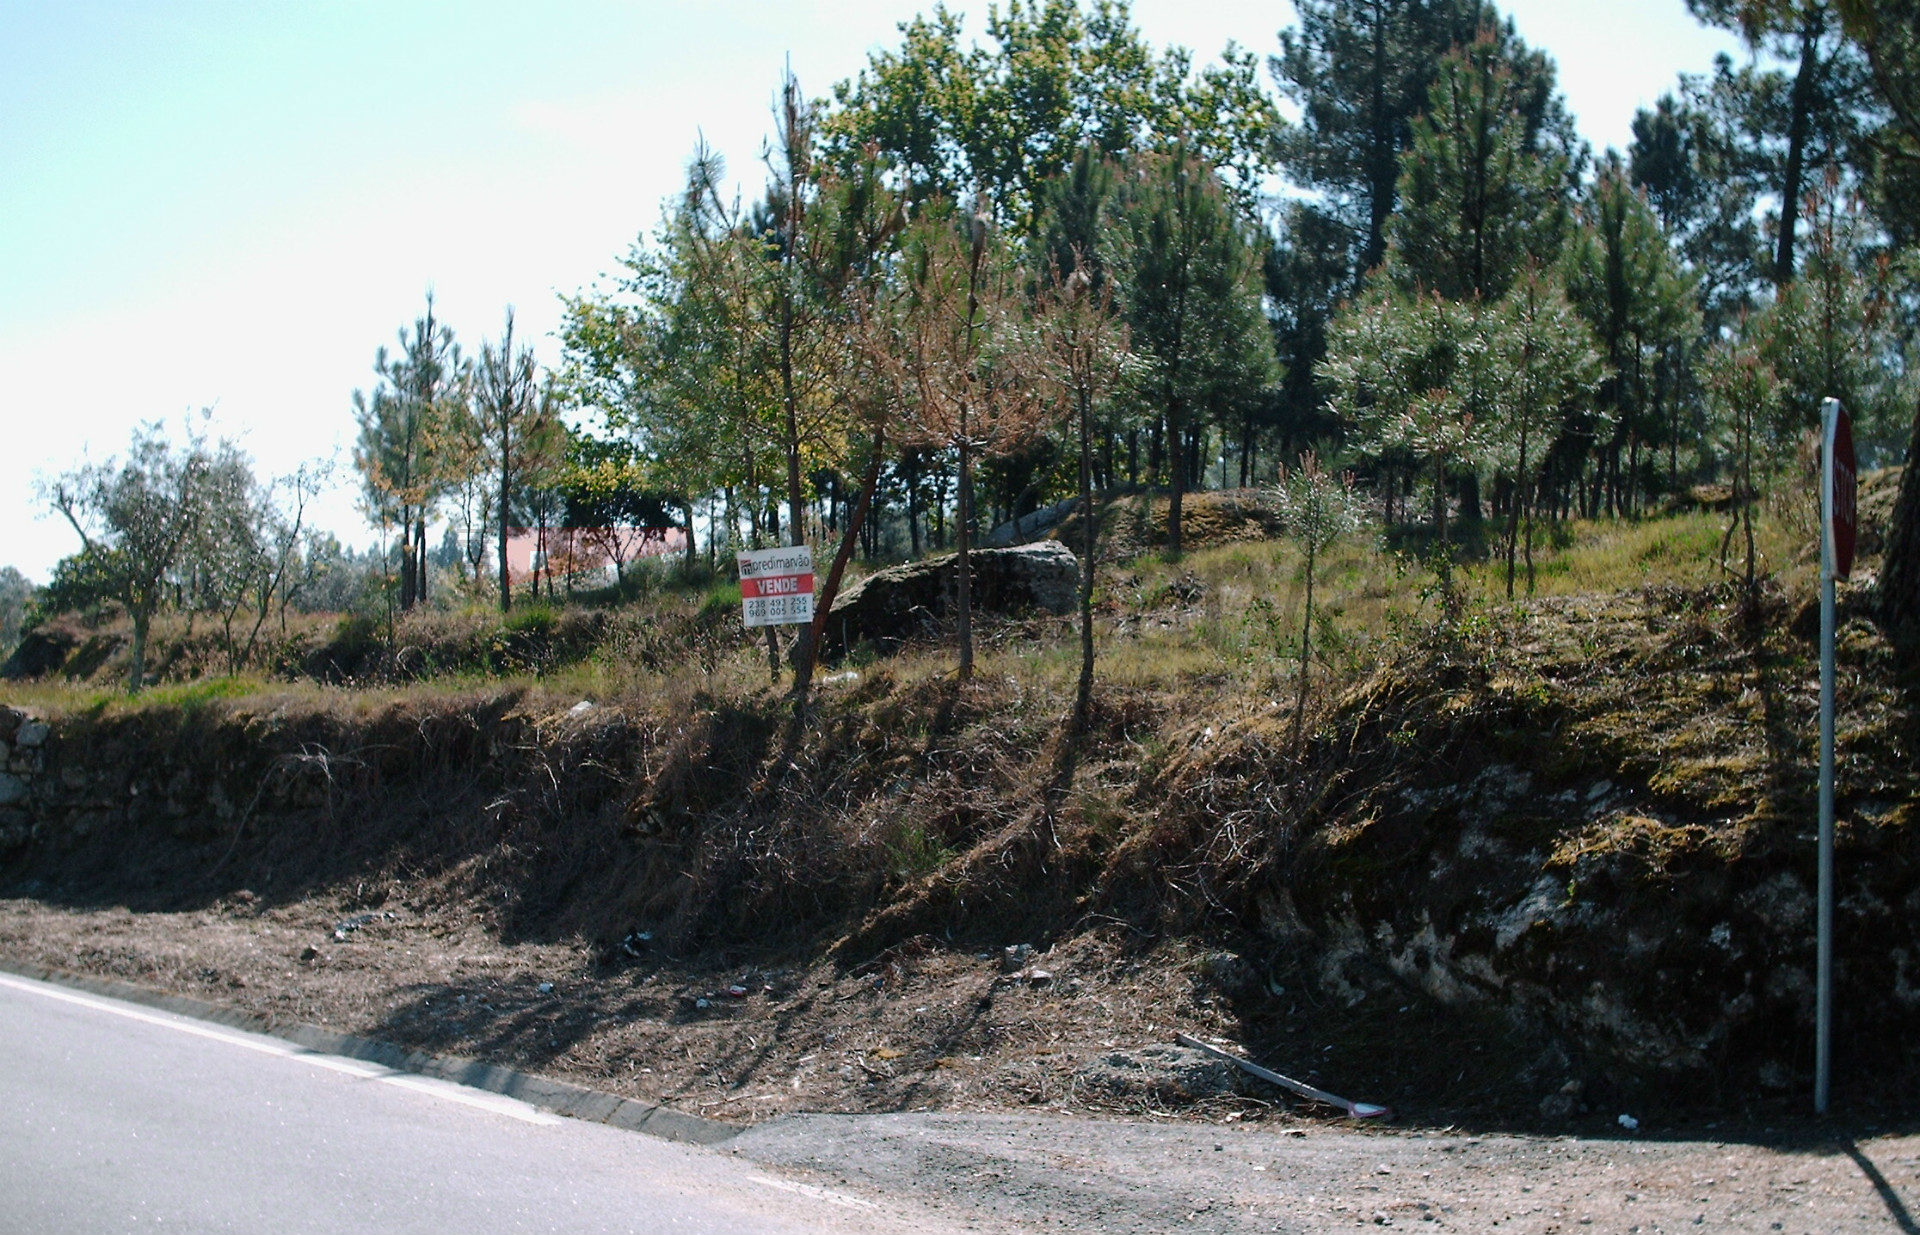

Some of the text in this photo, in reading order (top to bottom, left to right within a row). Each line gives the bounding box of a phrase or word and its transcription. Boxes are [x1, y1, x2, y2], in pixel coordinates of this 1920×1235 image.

[757, 578, 798, 595] VENDE
[748, 596, 807, 609] 238 493 255
[748, 608, 766, 617] 969
[770, 607, 786, 616] 005
